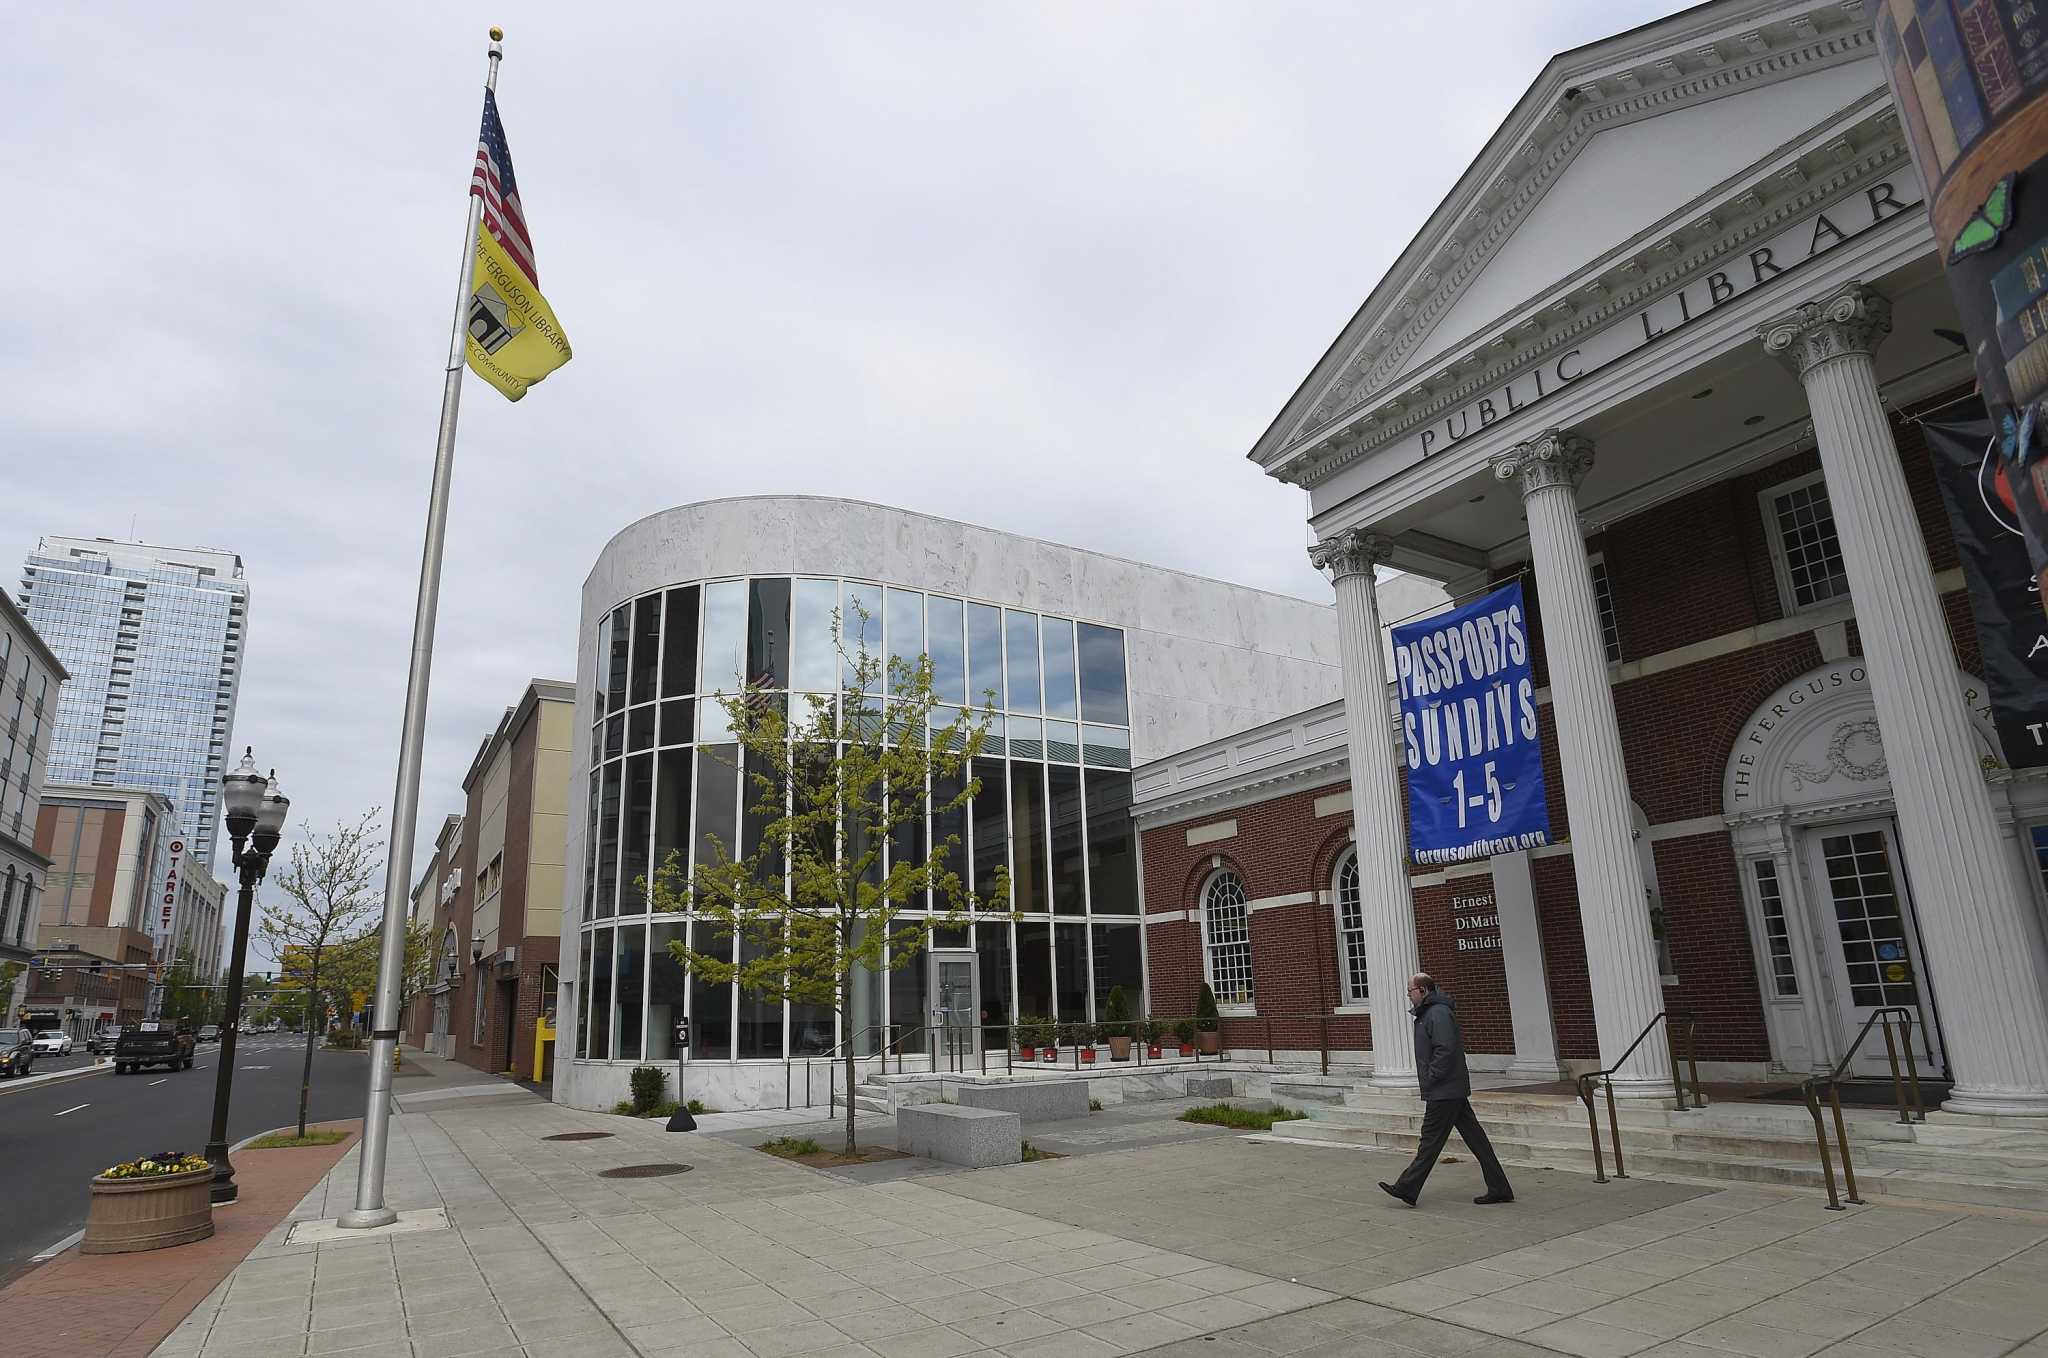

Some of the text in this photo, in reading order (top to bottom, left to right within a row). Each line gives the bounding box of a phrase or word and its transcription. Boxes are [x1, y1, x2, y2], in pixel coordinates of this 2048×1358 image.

[485, 256, 532, 315] FERGUSON
[529, 310, 571, 354] LIBRARY
[1420, 182, 1906, 457] PUBLIC LIBRAR
[474, 348, 521, 390] COMMUNITY
[1396, 604, 1527, 700] PASSPORTS
[1404, 678, 1537, 770] SUNDAYS
[1735, 667, 1865, 801] THE FERGUSO
[1452, 761, 1502, 829] 1-5
[1415, 830, 1547, 865] fergusonlibrary.org
[161, 857, 179, 929] TARGET
[1453, 894, 1493, 909] Ernest
[1456, 915, 1500, 930] DiMatt
[1457, 936, 1502, 950] Buildin
